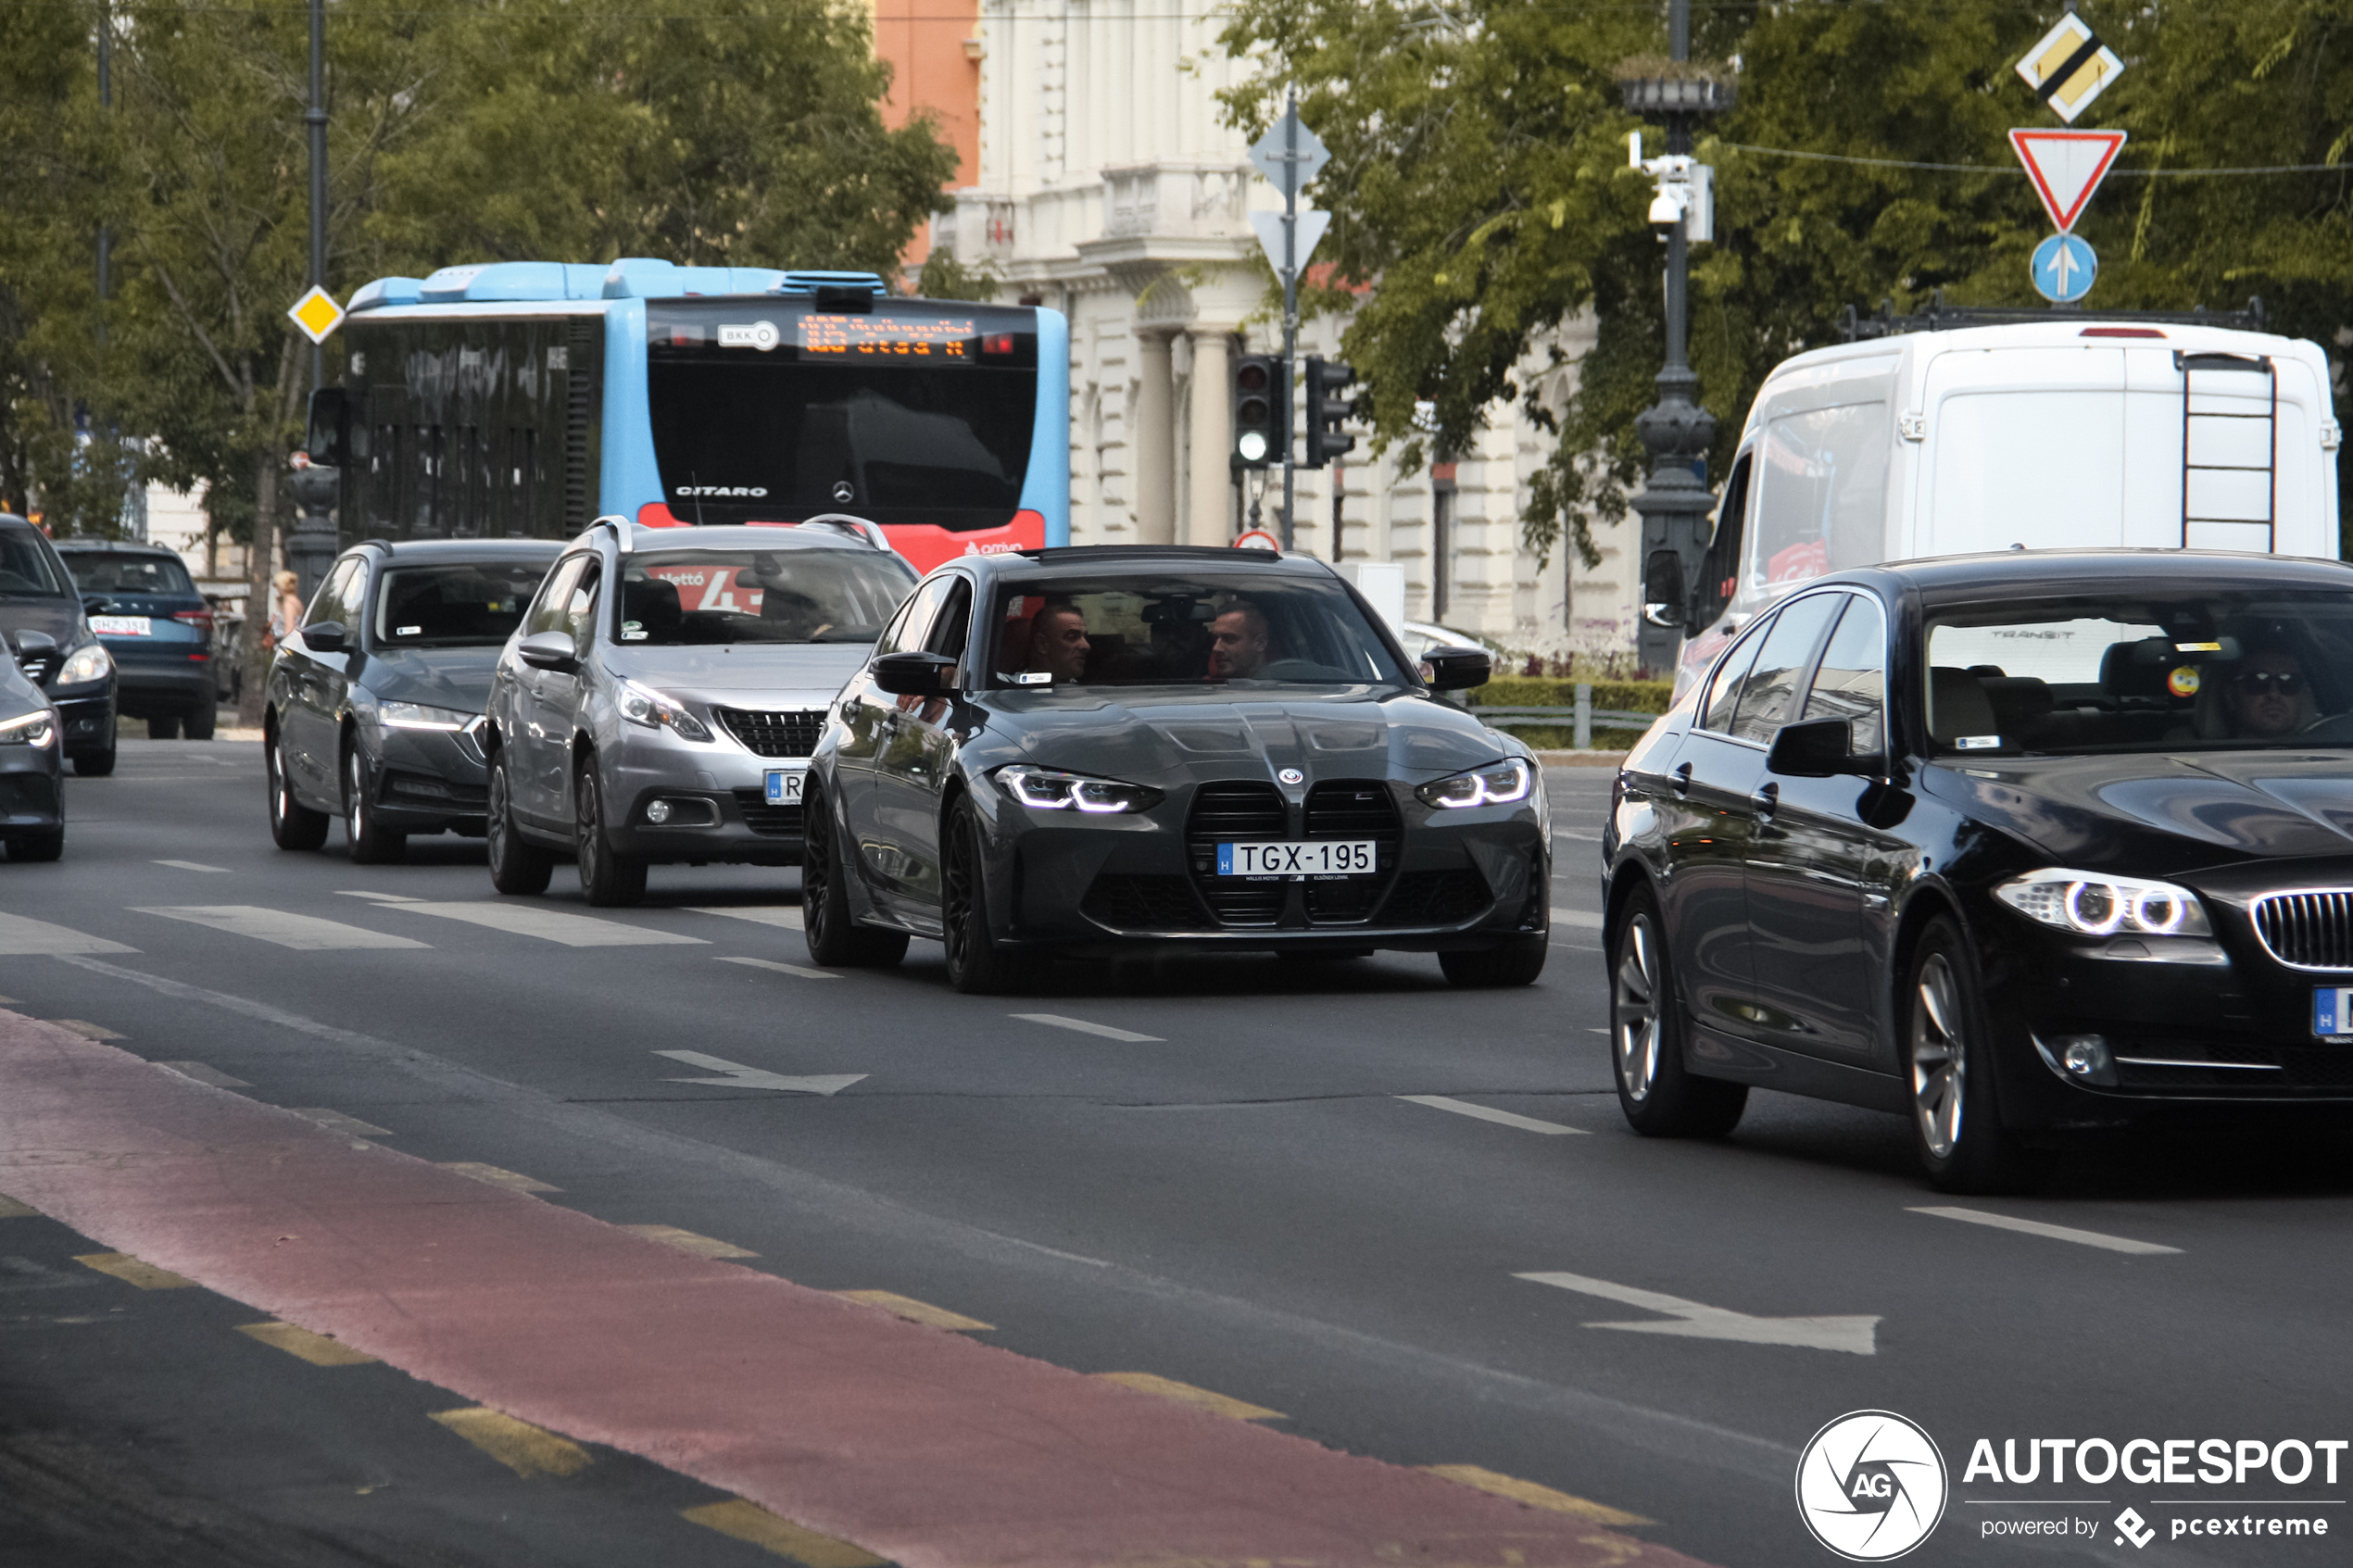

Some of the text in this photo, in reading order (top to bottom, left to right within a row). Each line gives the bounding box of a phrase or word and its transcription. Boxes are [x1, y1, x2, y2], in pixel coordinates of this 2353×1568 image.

[726, 331, 751, 341] BKK
[675, 486, 768, 497] CITARO
[1992, 631, 2075, 639] TRANSIT
[1221, 844, 1369, 872] H TGX-195
[2321, 1014, 2333, 1027] H
